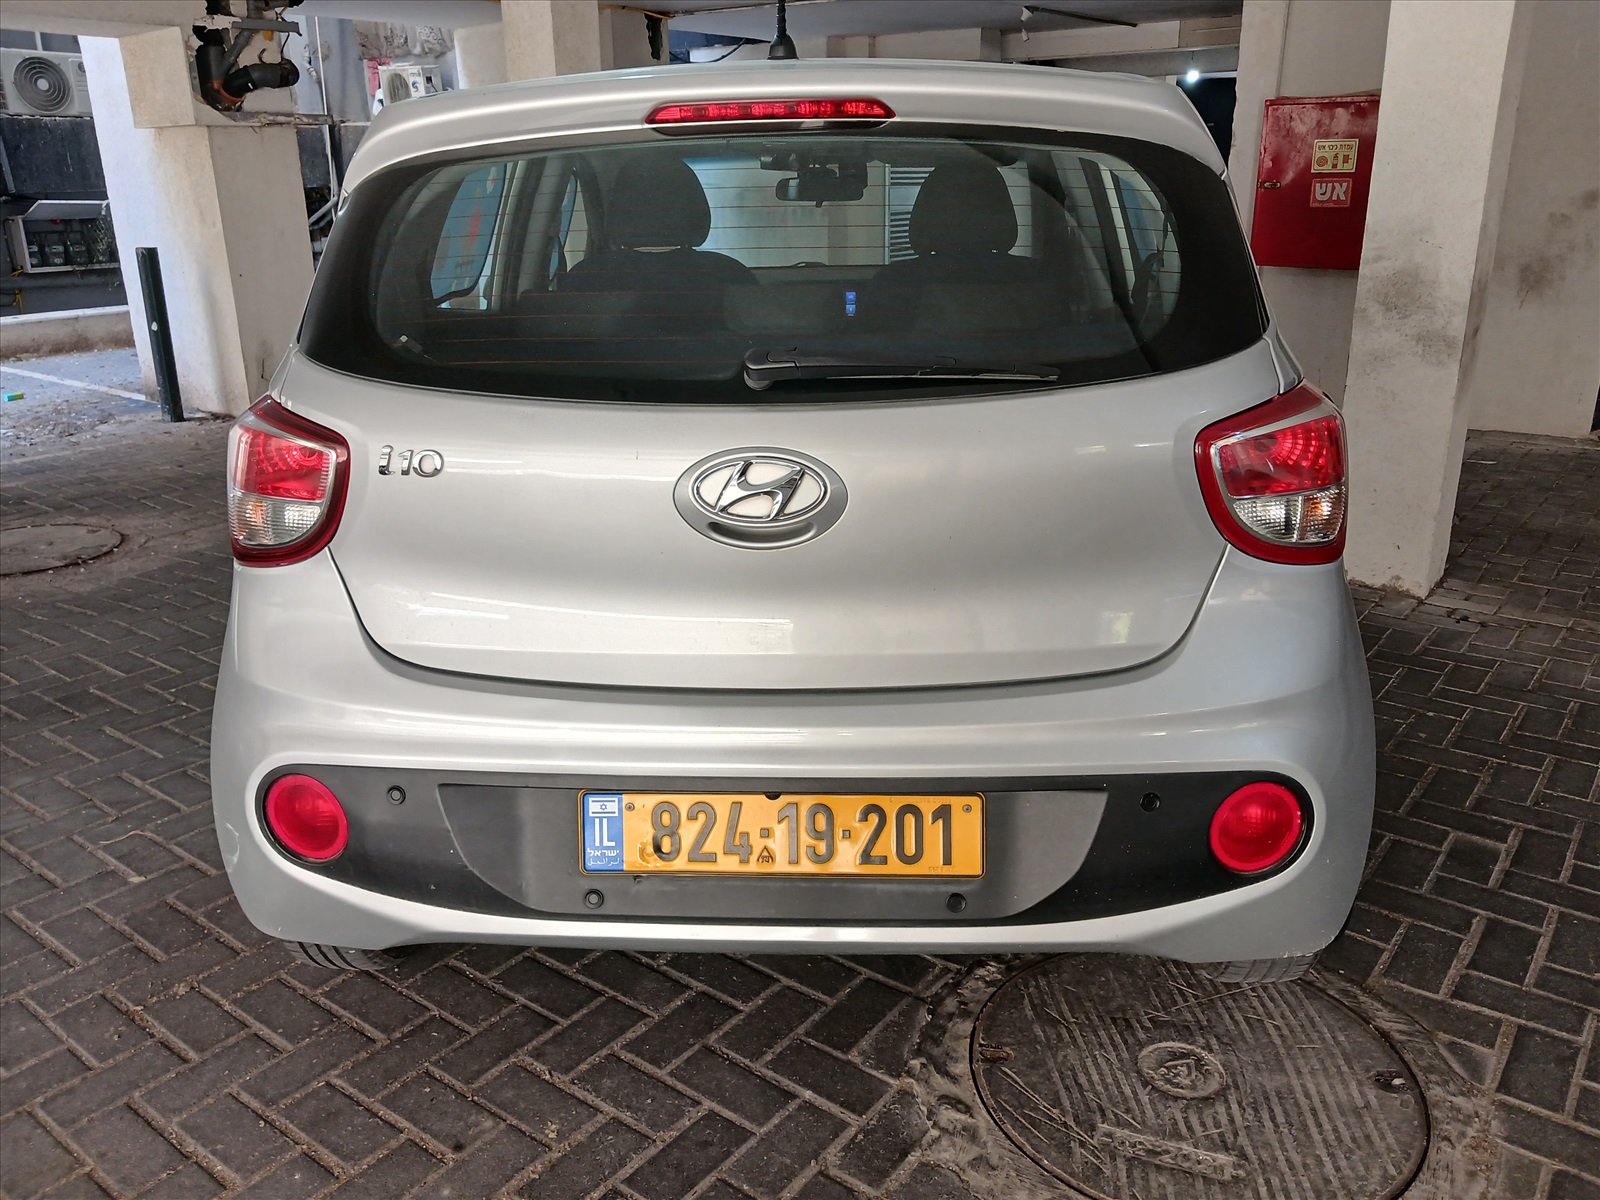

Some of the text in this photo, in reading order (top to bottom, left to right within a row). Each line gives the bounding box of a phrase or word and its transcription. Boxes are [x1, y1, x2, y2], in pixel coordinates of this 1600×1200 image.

[1315, 182, 1348, 201] אש
[378, 444, 444, 478] i10
[594, 817, 616, 847] IL
[587, 847, 620, 857] ישראל
